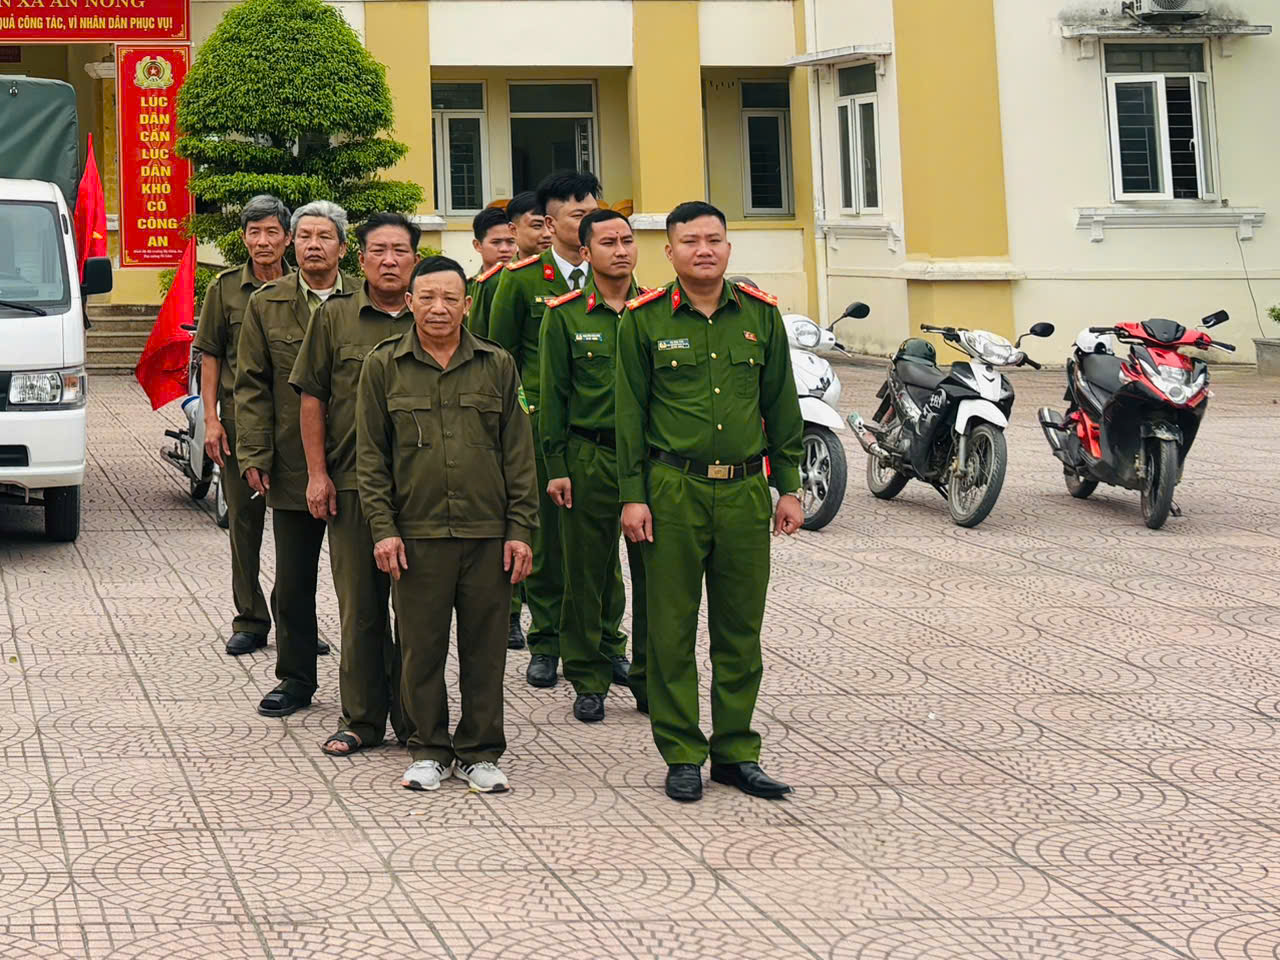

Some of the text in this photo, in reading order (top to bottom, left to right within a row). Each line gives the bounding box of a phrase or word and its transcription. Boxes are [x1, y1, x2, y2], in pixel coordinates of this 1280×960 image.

[18, 15, 43, 29] CÔNG
[46, 15, 66, 30] TÁC,
[68, 15, 77, 29] VÌ
[80, 15, 106, 29] NHÂN
[108, 15, 128, 29] DÂN
[130, 16, 155, 31] PHỤC
[157, 16, 173, 31] VỤ!
[140, 94, 168, 107] LÚC
[139, 111, 170, 125] DÂN
[141, 146, 169, 159] LÚC
[140, 163, 172, 177] DÂN
[141, 181, 171, 195] KHÓ
[147, 198, 167, 212] CÓ
[137, 216, 178, 229] CÔNG
[147, 235, 168, 247] AN
